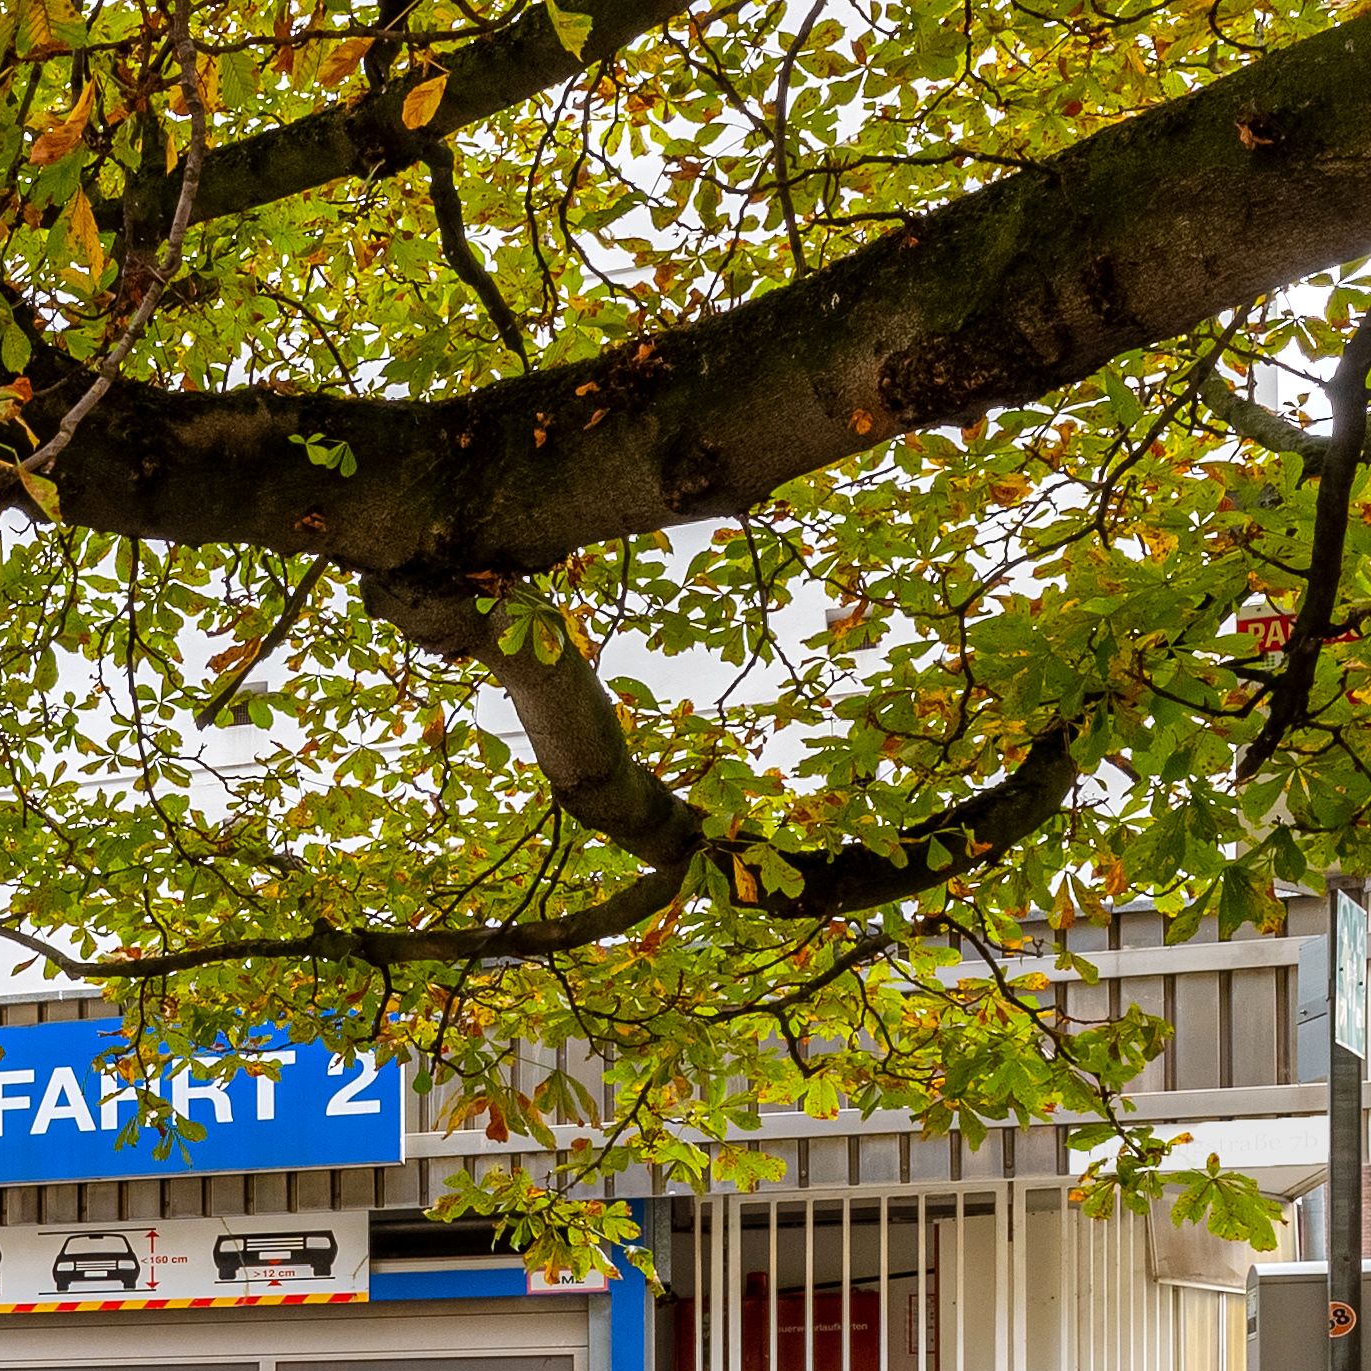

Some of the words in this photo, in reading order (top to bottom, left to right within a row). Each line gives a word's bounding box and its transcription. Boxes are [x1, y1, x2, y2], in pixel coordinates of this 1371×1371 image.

[325, 1046, 381, 1117] 2
[172, 1256, 188, 1264] cm
[277, 1270, 295, 1278] cm
